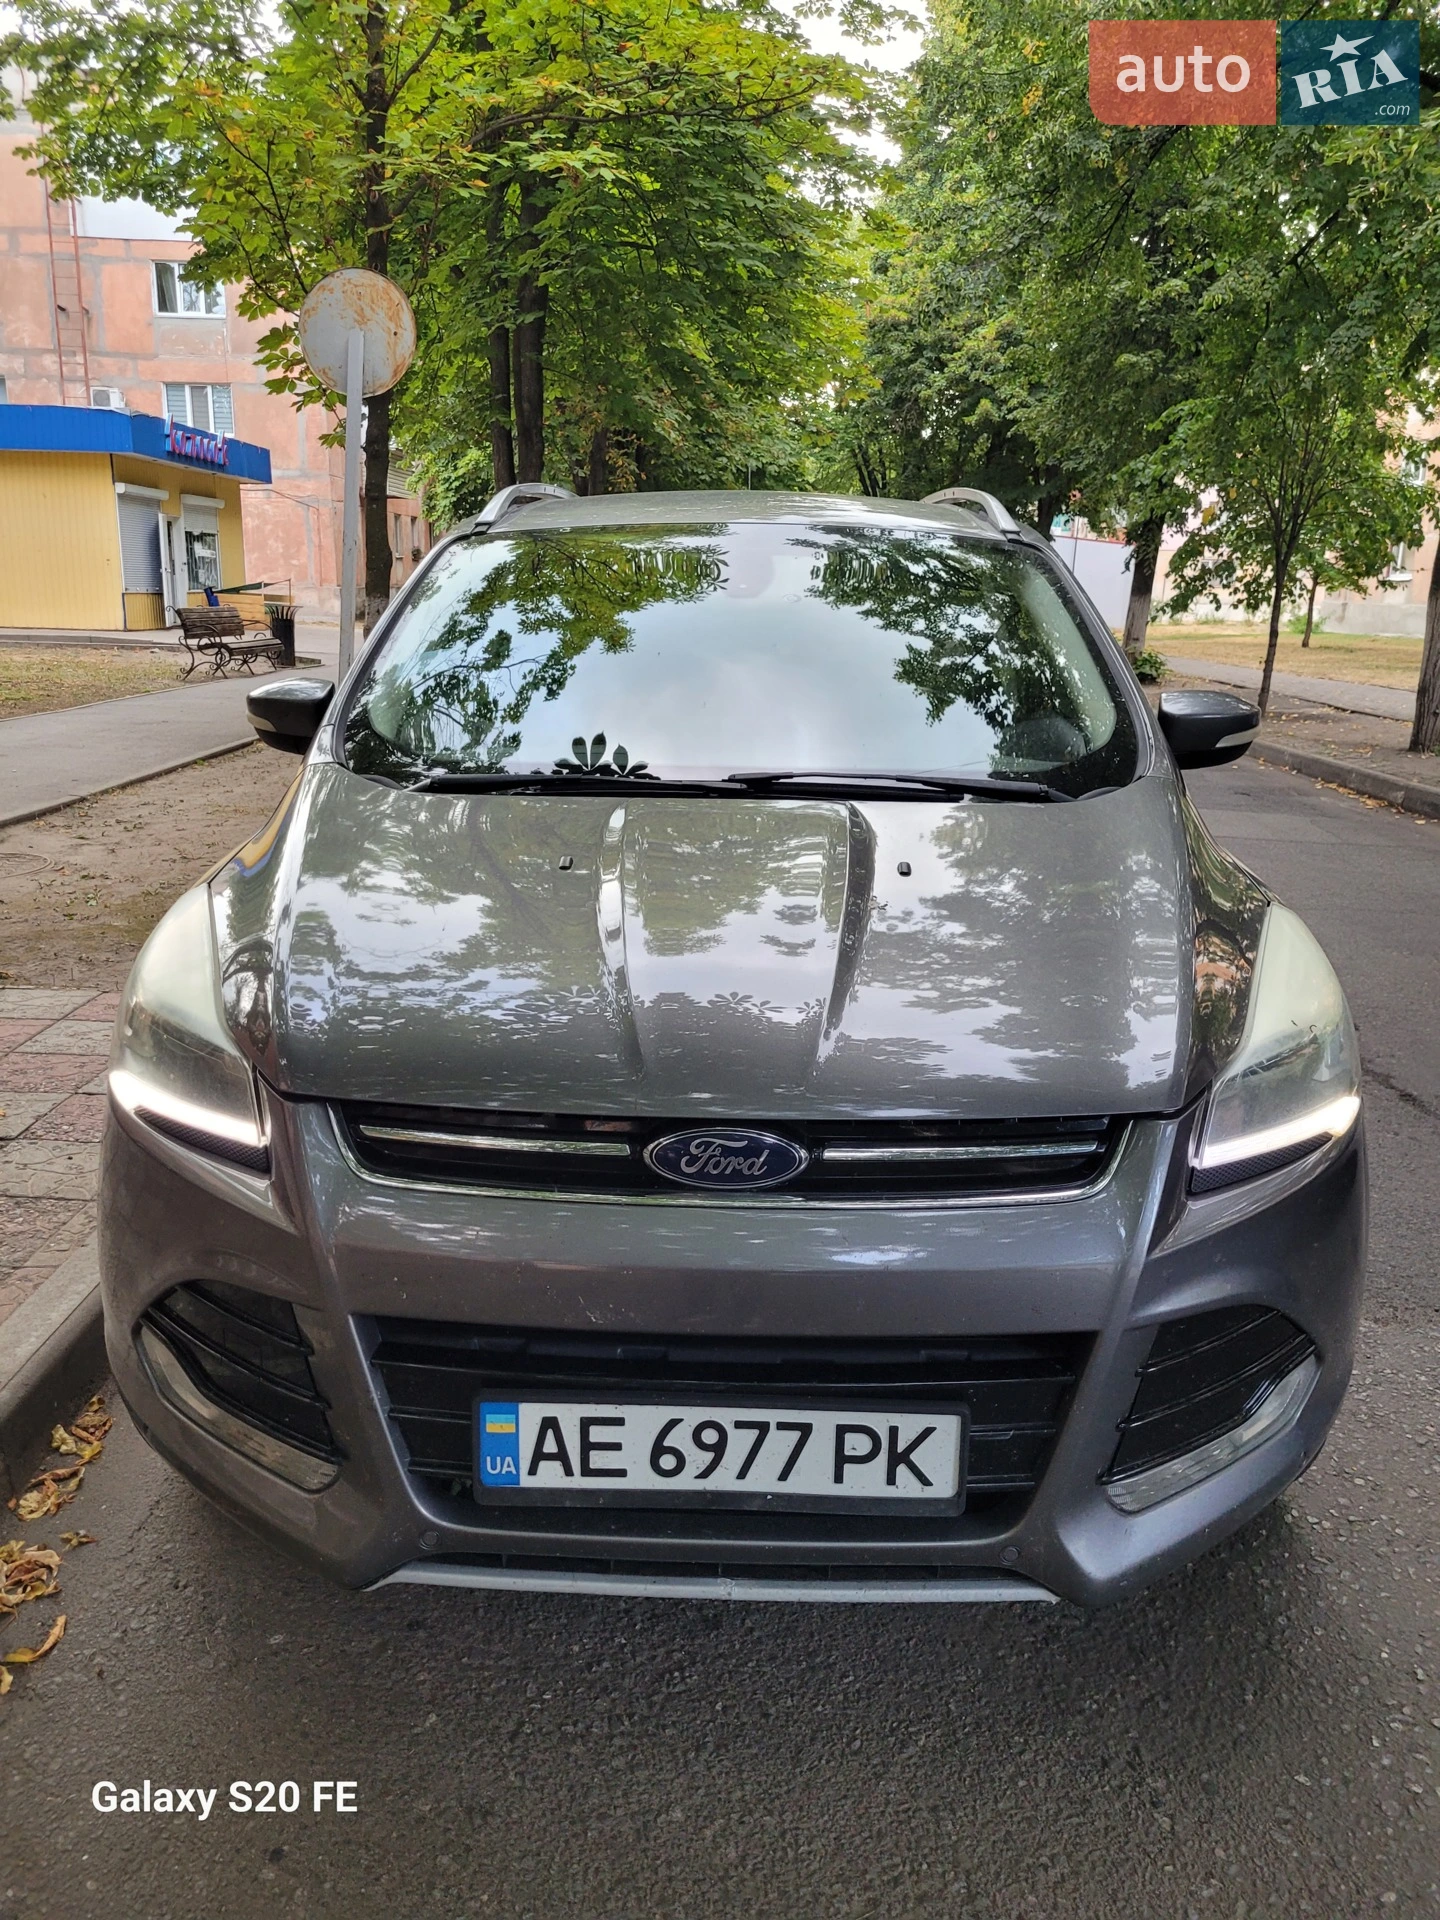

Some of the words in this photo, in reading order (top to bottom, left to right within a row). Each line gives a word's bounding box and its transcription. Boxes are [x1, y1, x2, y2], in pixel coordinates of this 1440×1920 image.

[680, 1137, 770, 1176] Ford
[486, 1455, 517, 1475] UA
[527, 1416, 628, 1478] AE
[649, 1418, 813, 1482] 6977
[833, 1424, 937, 1486] PK
